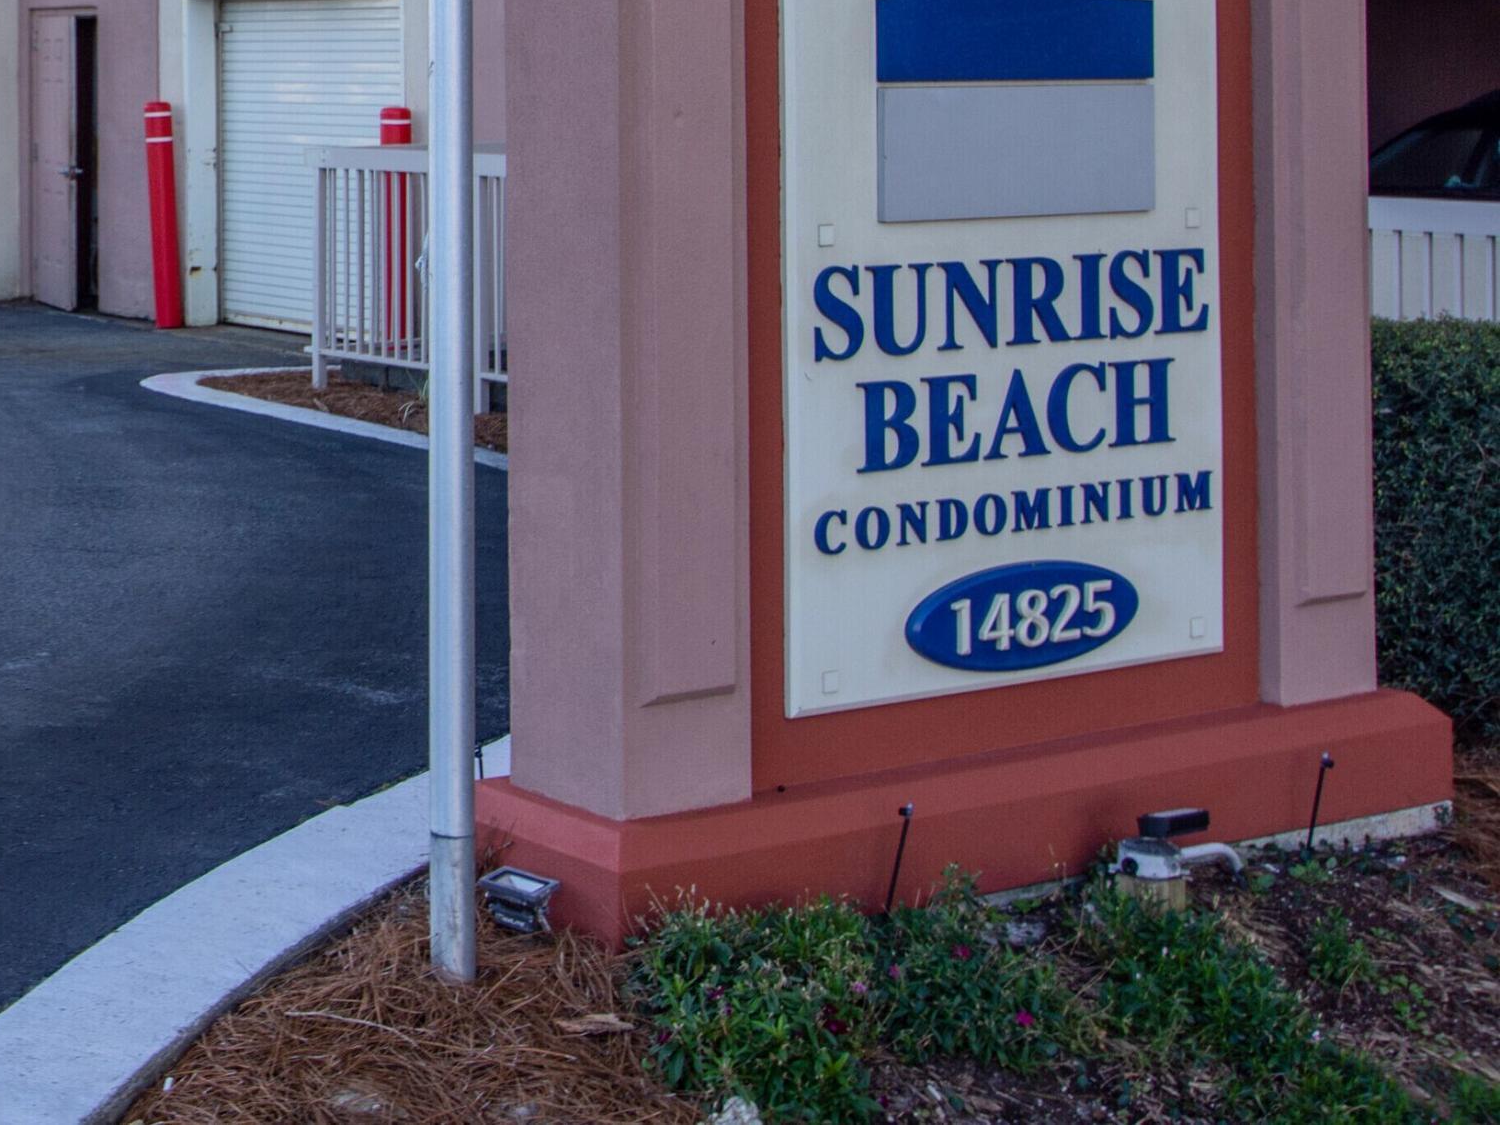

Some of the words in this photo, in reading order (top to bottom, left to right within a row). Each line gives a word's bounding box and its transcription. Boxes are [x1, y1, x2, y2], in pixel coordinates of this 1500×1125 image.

[812, 247, 1210, 362] SUNRISE
[856, 357, 1176, 475] BEACH
[814, 469, 1214, 556] CONDOMINIUM
[948, 579, 1117, 657] 14825
